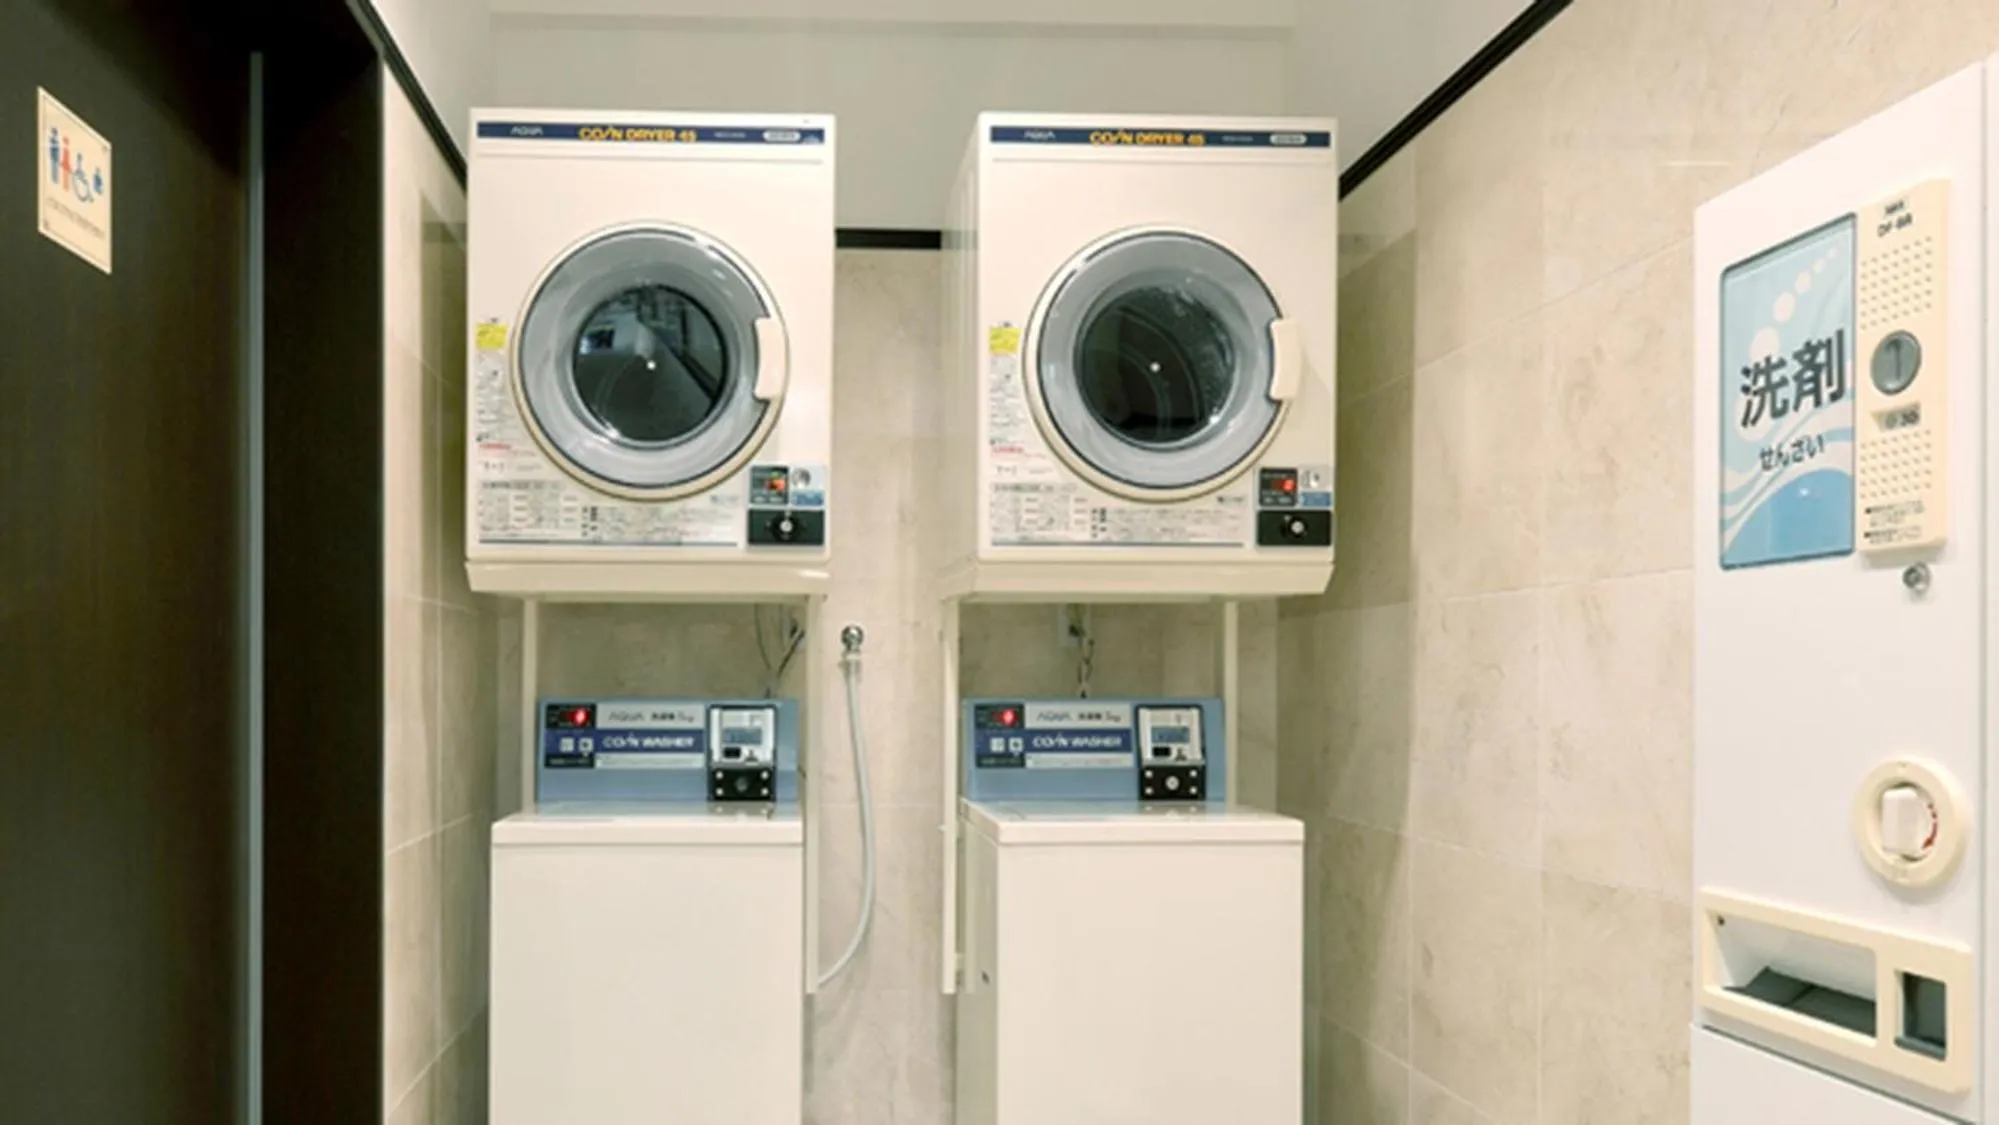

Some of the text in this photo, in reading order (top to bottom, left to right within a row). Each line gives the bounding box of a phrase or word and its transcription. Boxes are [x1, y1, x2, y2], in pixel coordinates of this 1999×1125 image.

[626, 127, 675, 142] DRYER
[1136, 131, 1184, 145] DRYER
[1740, 328, 1846, 429] 洗剤
[1759, 433, 1825, 471] せんざい
[609, 711, 644, 722] AQUA
[642, 736, 695, 748] WASHER
[1071, 736, 1122, 748] WASHER
